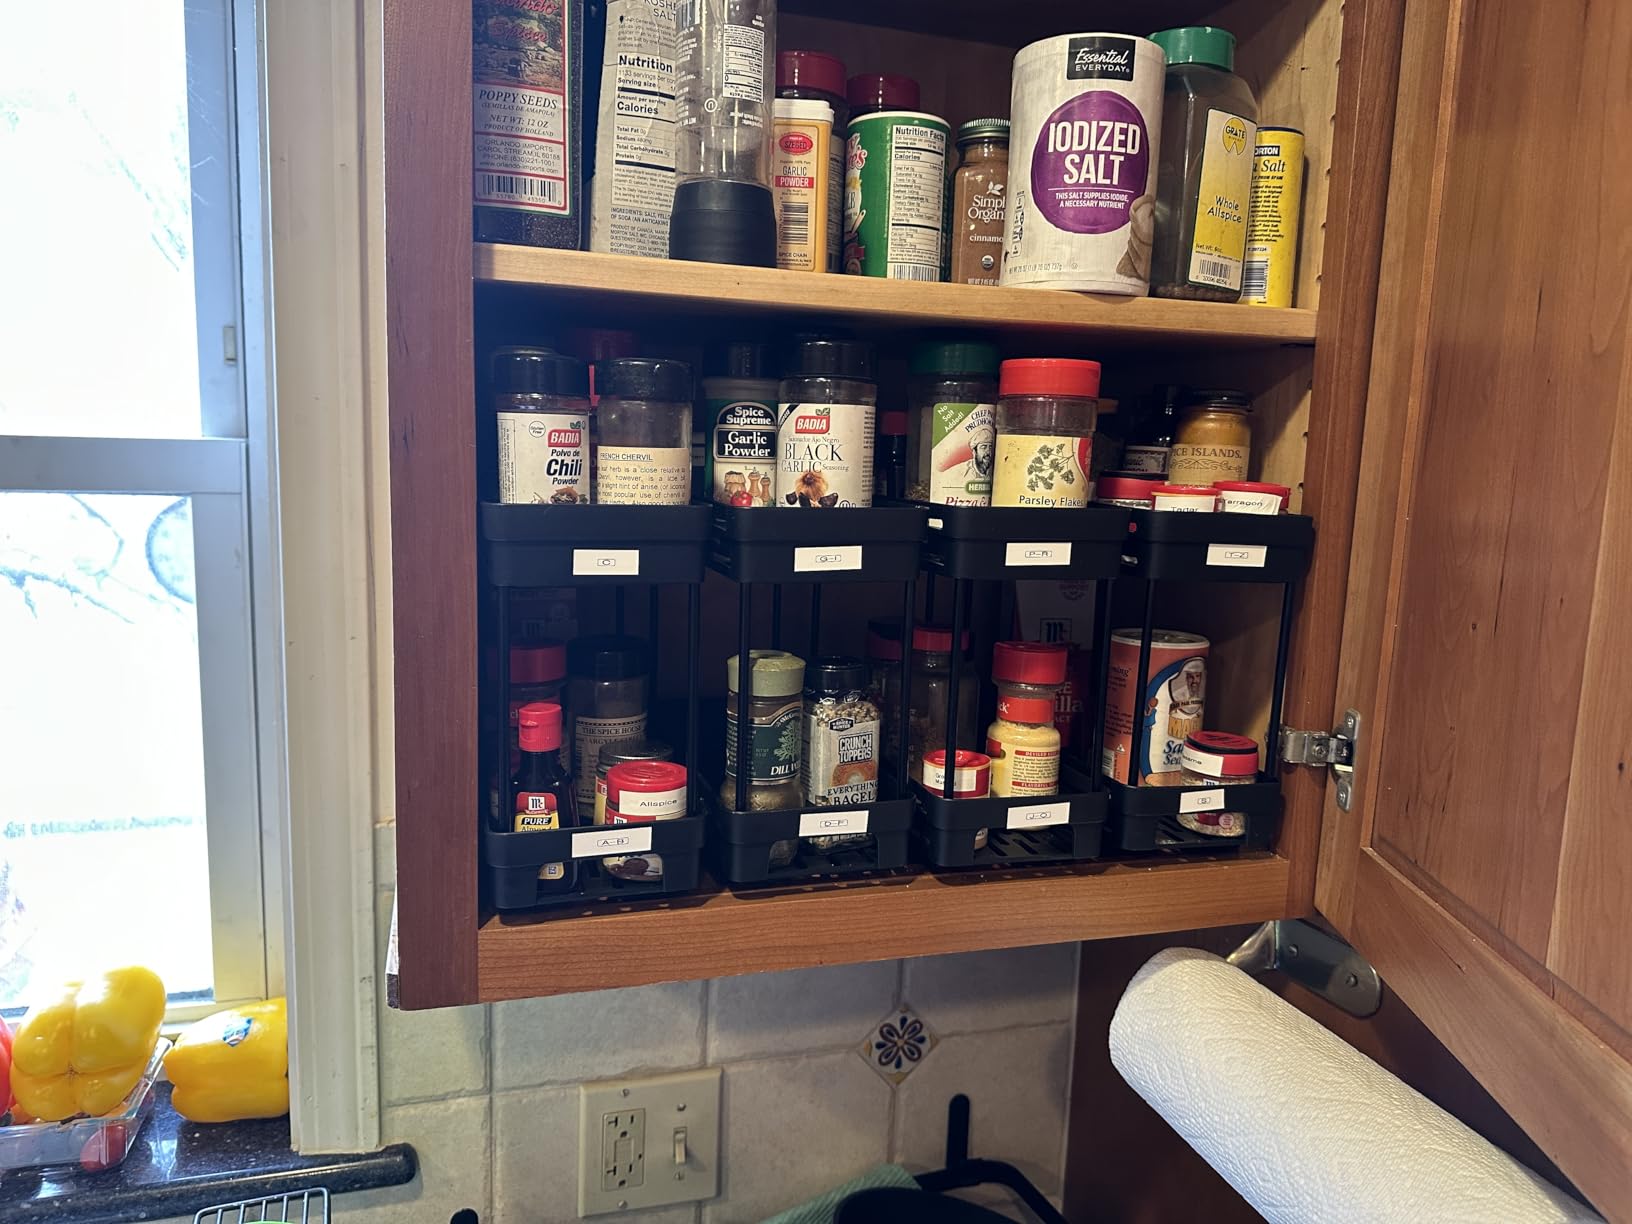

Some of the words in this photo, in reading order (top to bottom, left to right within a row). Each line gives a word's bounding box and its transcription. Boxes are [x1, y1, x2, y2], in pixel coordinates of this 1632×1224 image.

[654, 8, 676, 22] SALT
[1075, 48, 1129, 64] Essential
[618, 55, 672, 74] Nutrition
[618, 77, 642, 86] Serving
[644, 80, 656, 88] size
[480, 90, 518, 103] POPPY
[520, 94, 558, 110] SEEDS
[617, 101, 659, 115] Calories
[490, 114, 508, 122] NET
[527, 118, 535, 126] 12
[538, 120, 549, 128] OZ
[525, 127, 554, 137] HOLLAND
[616, 134, 636, 142] Sodium
[896, 126, 928, 138] Nutrition
[930, 131, 944, 142] Facts
[1048, 120, 1141, 154] IODIZED
[1226, 126, 1245, 139] GRATE
[522, 144, 552, 152] IMPORTS
[630, 144, 664, 154] Carbohydrate
[782, 166, 807, 176] GARLIC
[1064, 154, 1125, 186] SALT
[1261, 160, 1286, 172] Salt
[780, 177, 809, 188] POWDER
[1056, 192, 1068, 200] THIS
[1069, 192, 1083, 200] SALT
[1084, 192, 1110, 200] SUPPLIES
[1060, 200, 1064, 208] A
[1065, 200, 1098, 208] NECESSARY
[1099, 201, 1125, 210] NUTRIENT
[1216, 195, 1239, 210] Whole
[1208, 207, 1242, 223] Allspice
[735, 407, 764, 418] Spice
[937, 405, 948, 415] No
[942, 410, 954, 422] Salt
[726, 414, 772, 426] Supreme
[797, 418, 826, 430] BADIA
[944, 411, 964, 432] Added!
[551, 432, 580, 444] BADIA
[728, 432, 768, 444] Garlic
[812, 436, 822, 444] Ajo
[822, 437, 840, 445] Negro
[551, 449, 572, 457] Polvo
[600, 452, 620, 460] FRENCH
[724, 444, 770, 456] Powder
[785, 442, 845, 462] BLACK
[546, 458, 583, 476] Chili
[640, 466, 658, 474] close
[782, 459, 822, 473] GARLIC
[822, 463, 850, 472] Seasoning
[552, 478, 579, 486] Powder
[614, 492, 636, 500] popular
[1019, 495, 1056, 506] Parsley
[1060, 497, 1084, 506] Flakes
[840, 732, 872, 751] CRUNCH
[840, 748, 872, 763] TOPPERS
[770, 764, 790, 776] DILL
[834, 790, 875, 805] BAGEL
[524, 817, 550, 826] PURE
[1028, 812, 1048, 820] J-O
[602, 838, 624, 846] A-B
